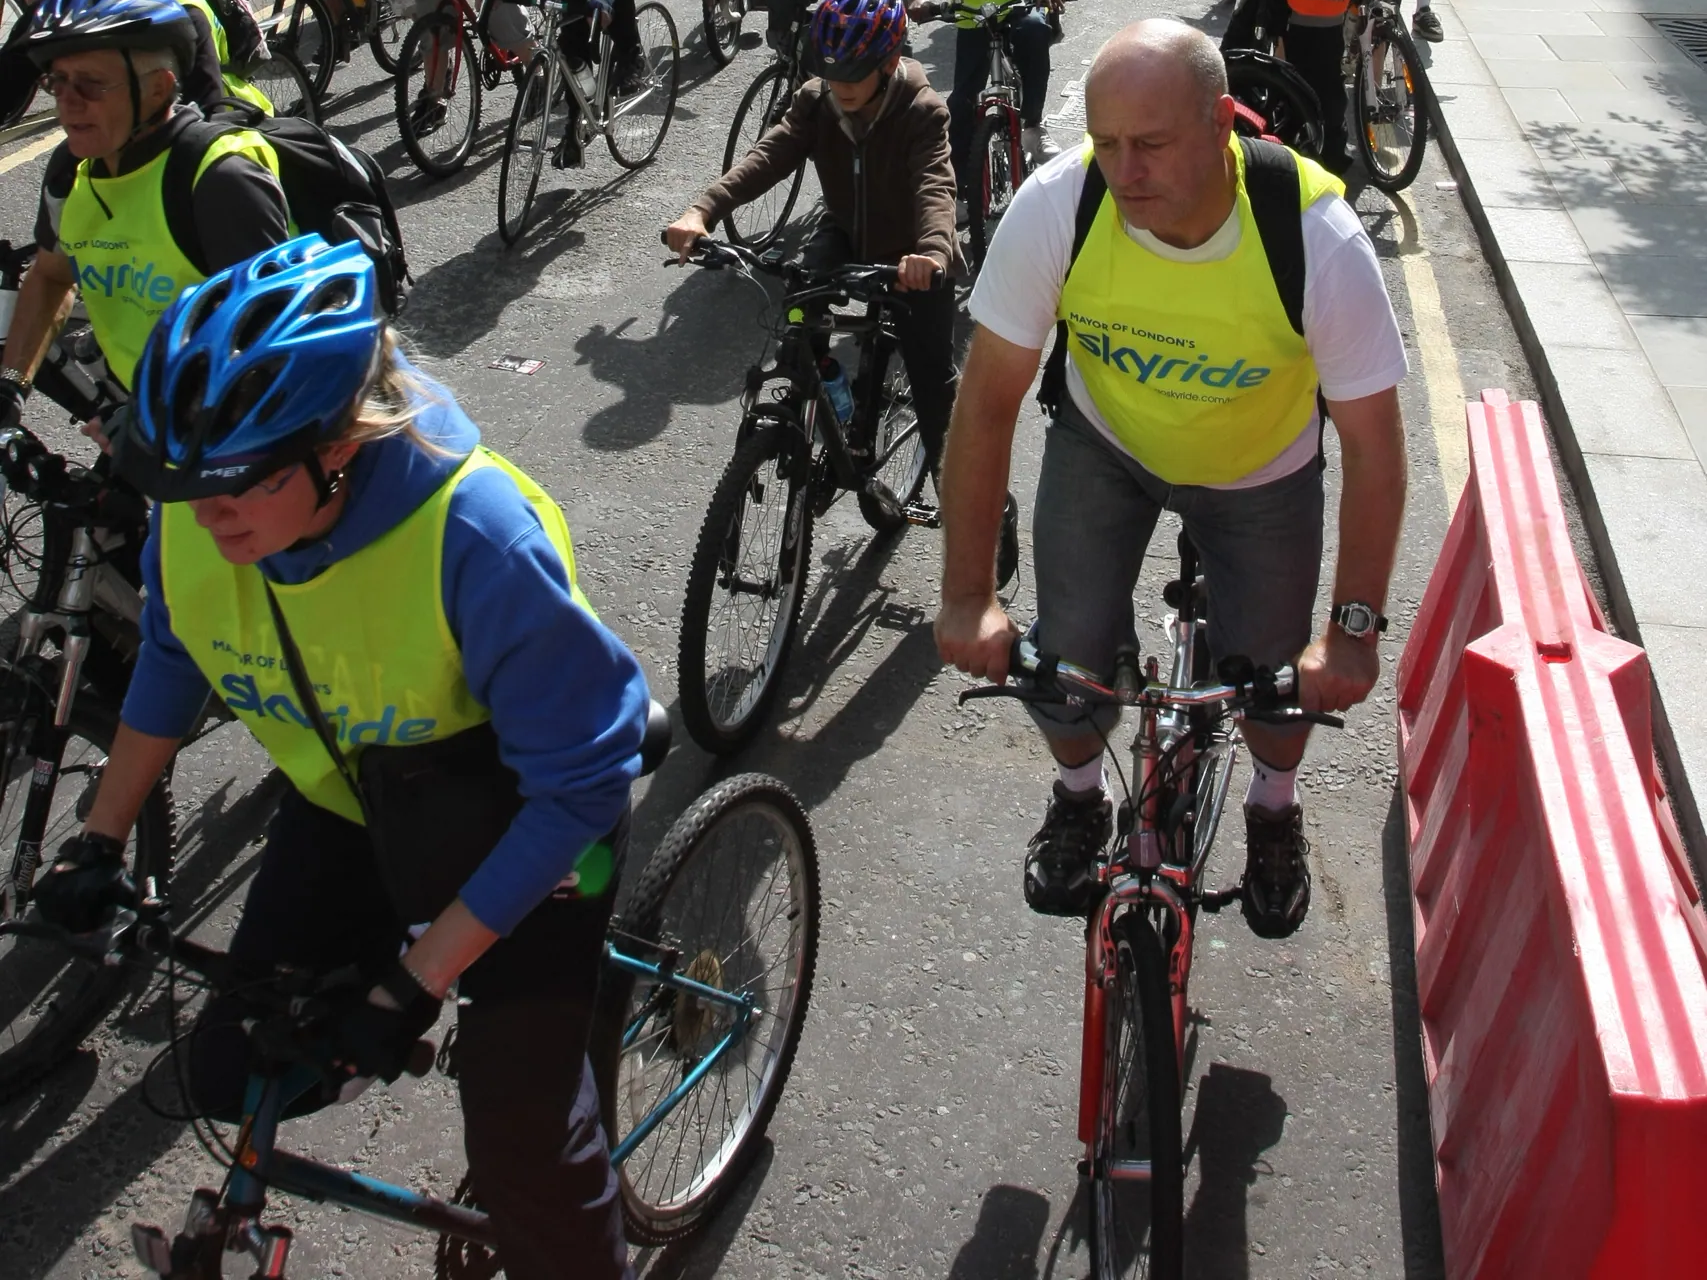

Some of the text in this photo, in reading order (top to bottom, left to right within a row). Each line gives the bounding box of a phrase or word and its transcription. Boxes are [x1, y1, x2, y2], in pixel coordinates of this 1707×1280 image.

[69, 255, 175, 303] kyride
[1070, 311, 1196, 349] MAYOR OF LONDON'S
[1075, 333, 1271, 390] skyride
[200, 465, 250, 478] MET
[256, 655, 276, 669] OF
